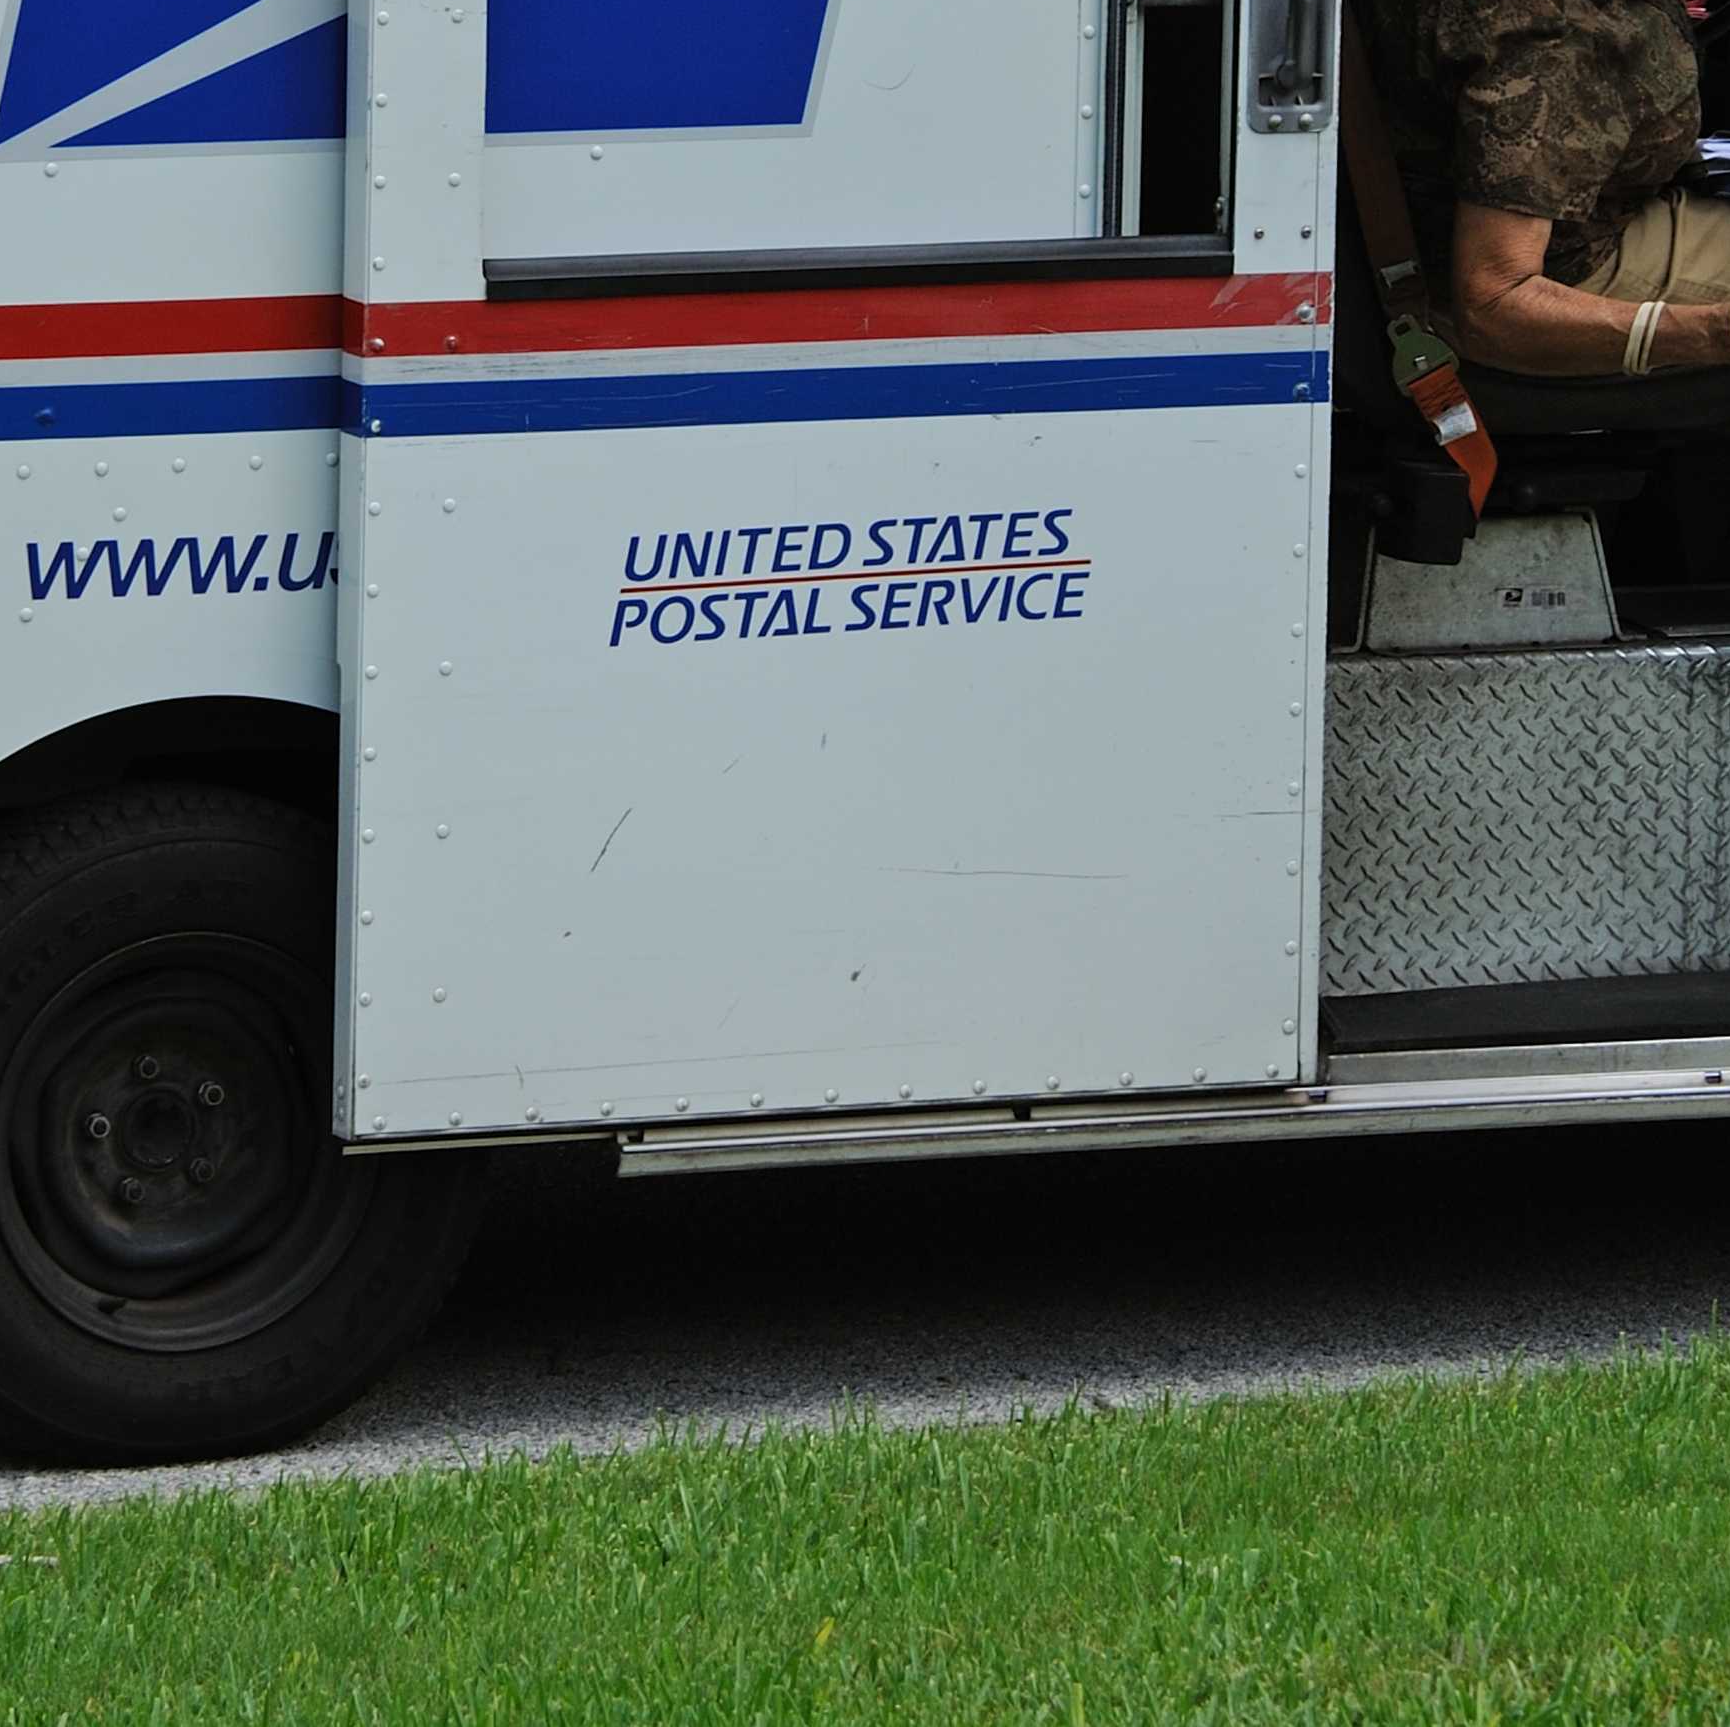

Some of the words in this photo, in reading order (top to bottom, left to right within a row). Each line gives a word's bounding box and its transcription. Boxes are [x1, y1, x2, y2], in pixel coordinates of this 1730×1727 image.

[26, 531, 340, 600] www.u
[623, 522, 852, 582] UNITED
[863, 508, 1073, 567] STATES
[609, 587, 832, 647] POSTAL
[845, 571, 1091, 631] SERVICE
